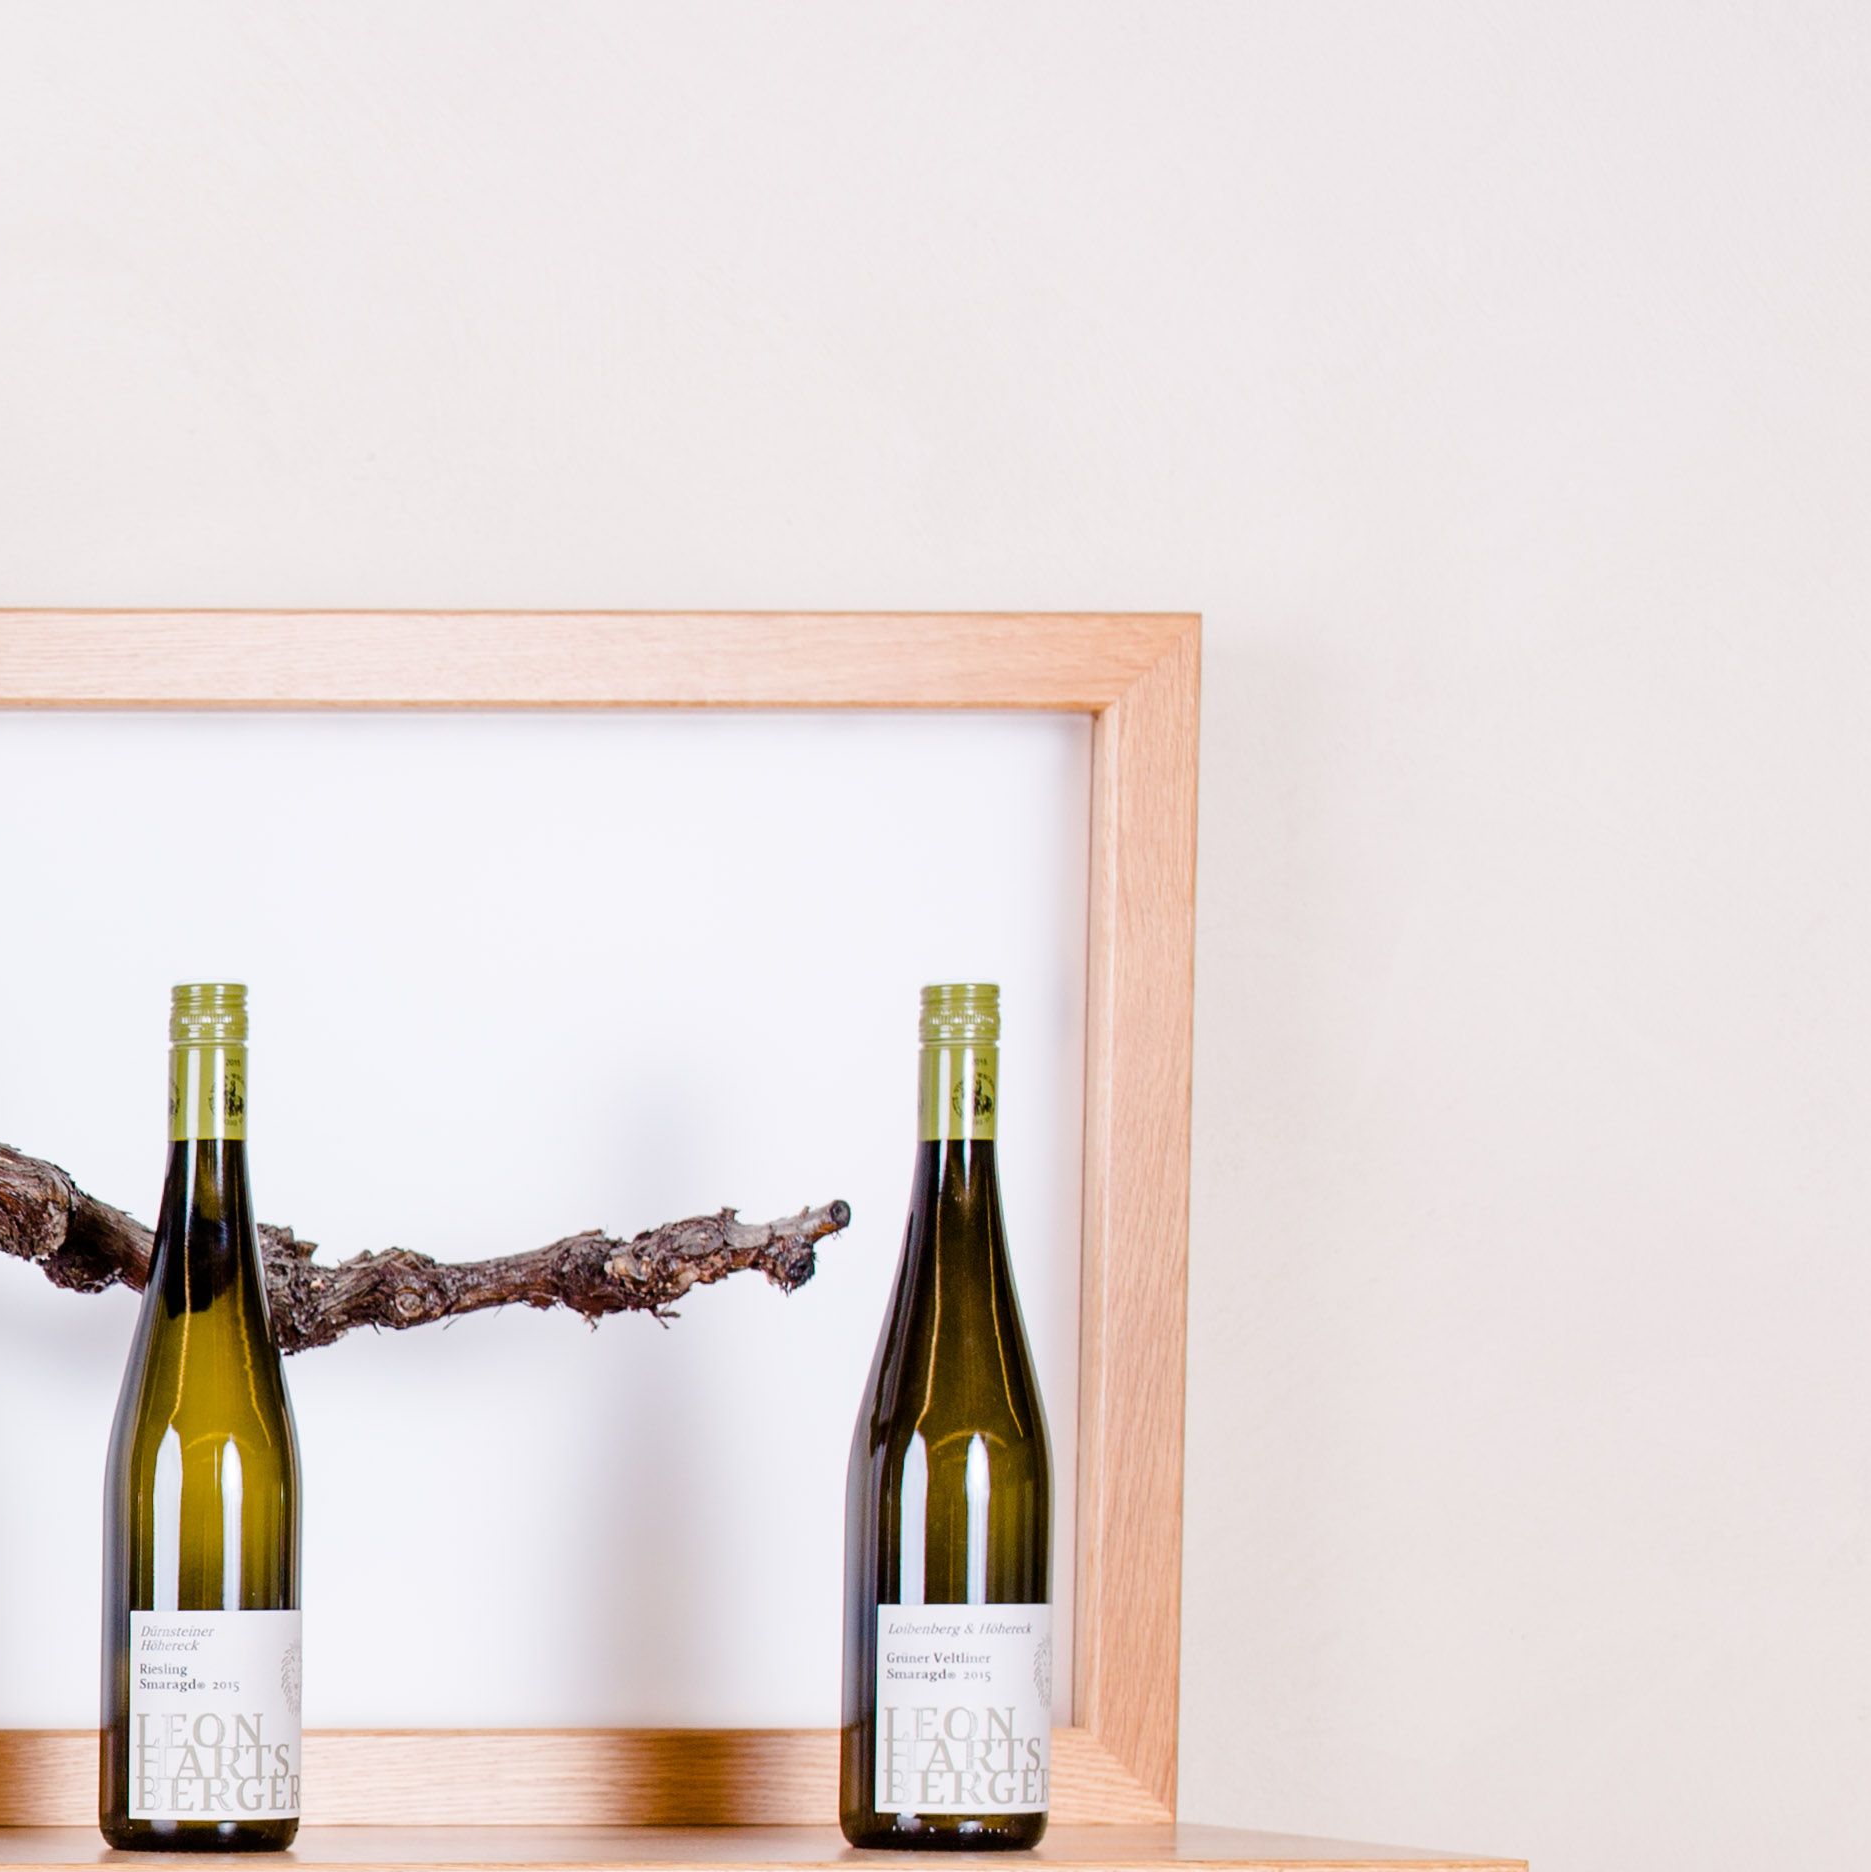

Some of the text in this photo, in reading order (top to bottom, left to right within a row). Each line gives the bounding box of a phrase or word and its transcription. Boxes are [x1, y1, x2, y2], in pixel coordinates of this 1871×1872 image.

[140, 1624, 215, 1638] Dürnsteiner
[888, 1622, 1033, 1637] Loibenberg & Höhereck
[141, 1639, 201, 1652] Höhereck
[886, 1652, 992, 1664] Grüner Veltliner
[139, 1663, 188, 1677] Riesling
[963, 1671, 992, 1683] 2015
[212, 1680, 241, 1692] 2015
[136, 1712, 264, 1749] LEON
[884, 1705, 1016, 1743] LEON
[136, 1744, 290, 1781] HARTS
[884, 1737, 1042, 1774] HARTS
